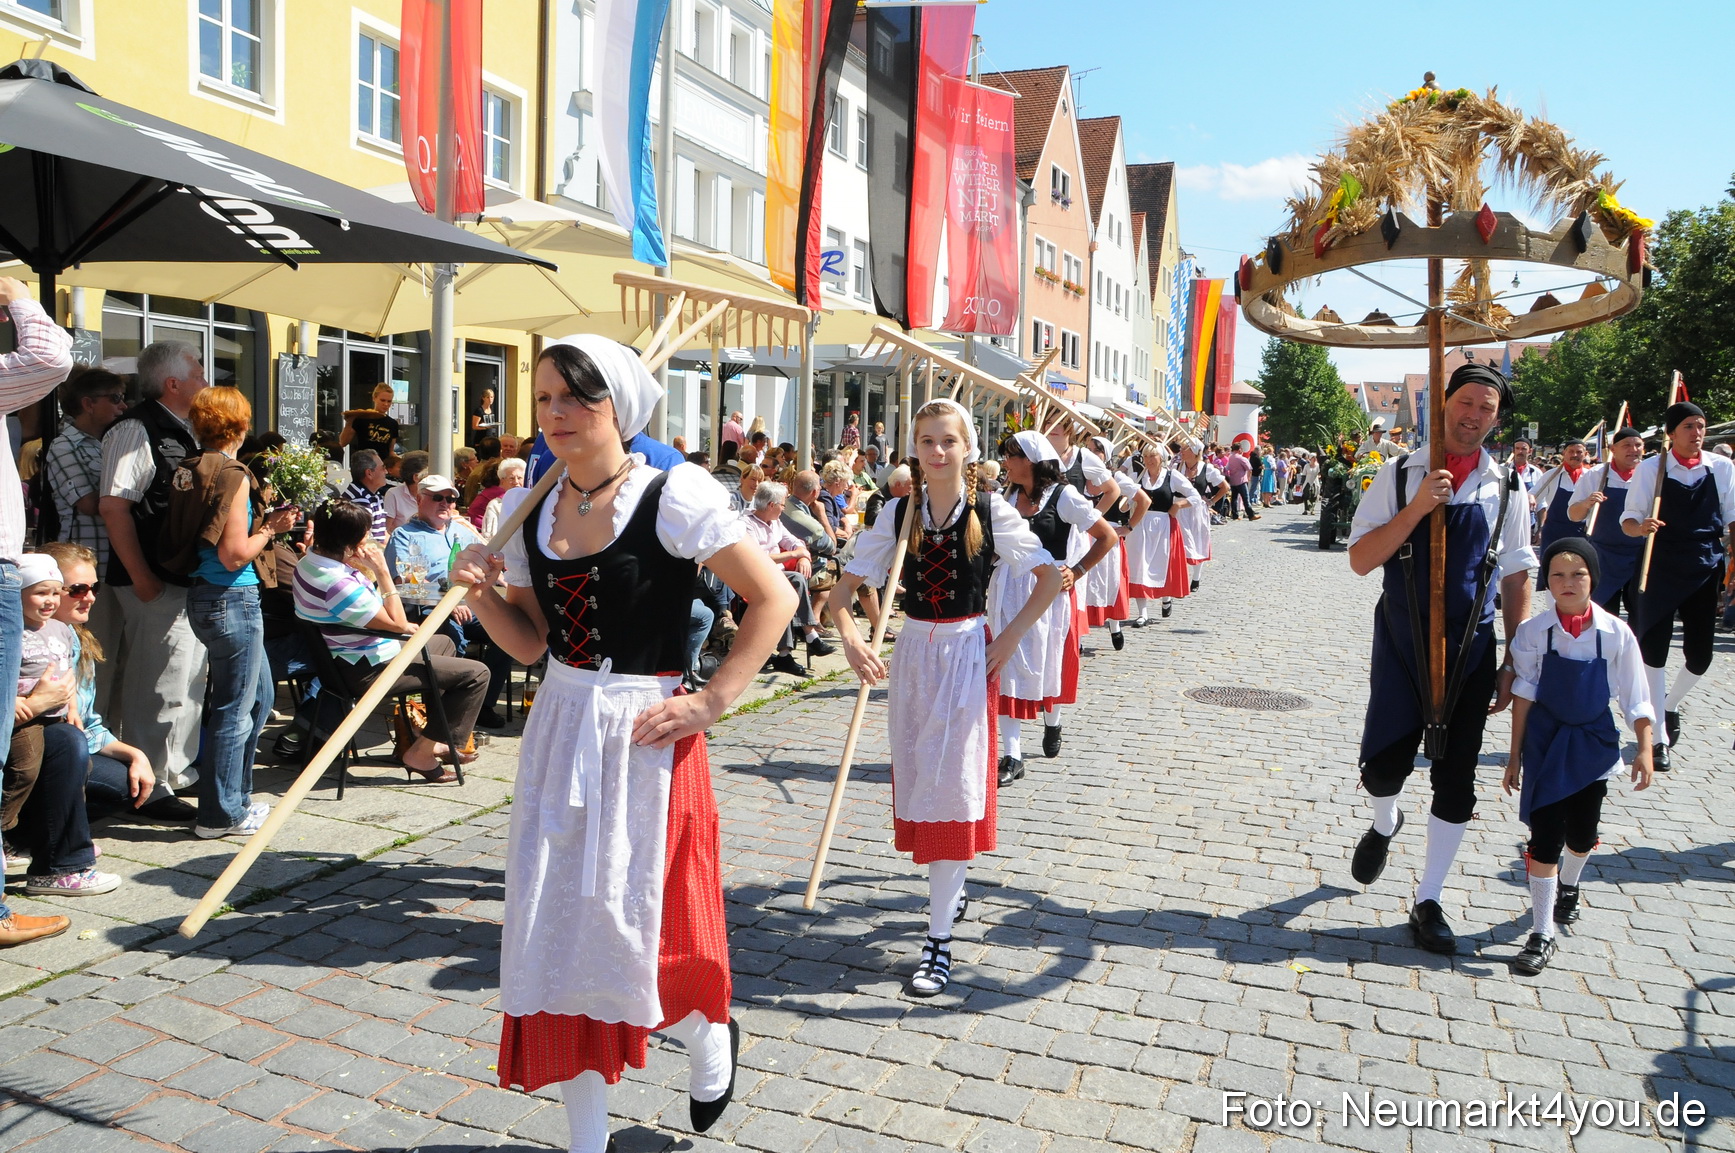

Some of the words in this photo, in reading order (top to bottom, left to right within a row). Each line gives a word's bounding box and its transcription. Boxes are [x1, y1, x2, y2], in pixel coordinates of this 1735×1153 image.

[948, 104, 971, 124] Wir
[976, 108, 1009, 132] feiern
[520, 361, 529, 373] 24
